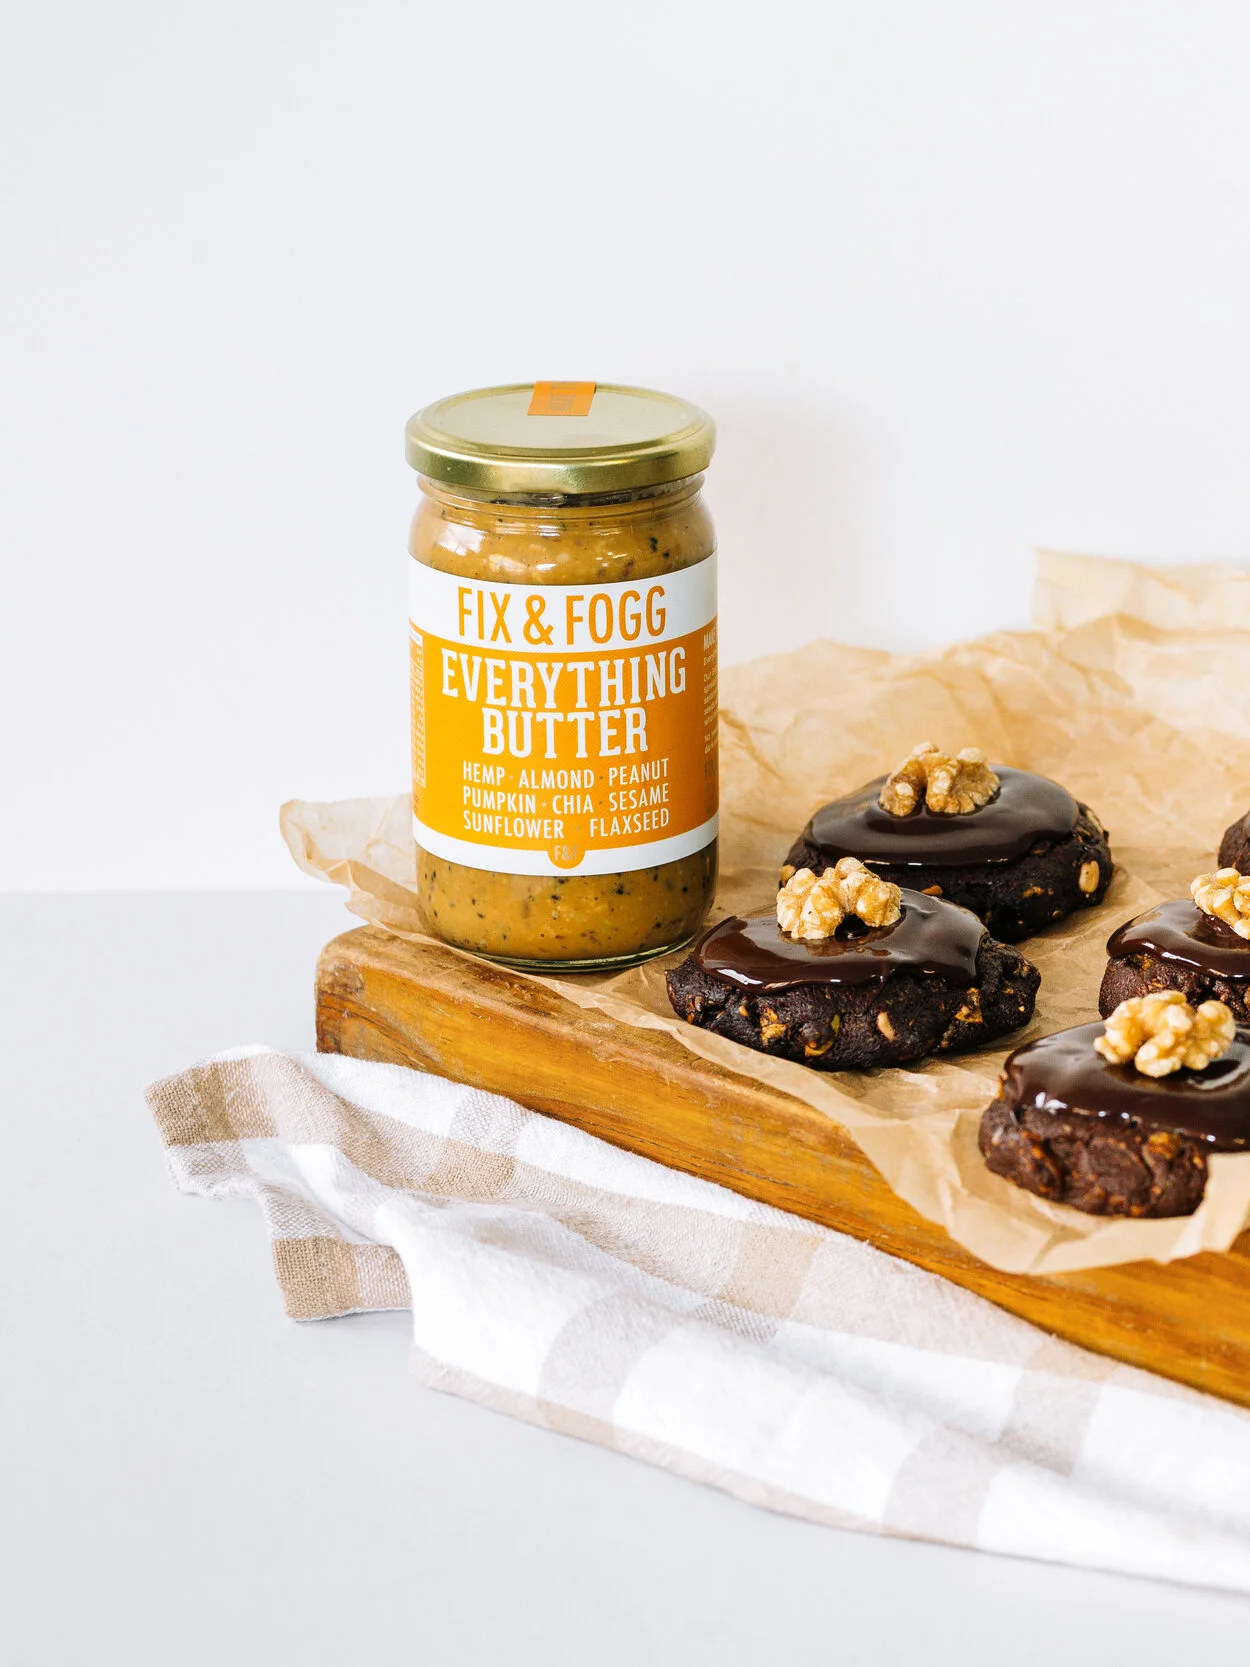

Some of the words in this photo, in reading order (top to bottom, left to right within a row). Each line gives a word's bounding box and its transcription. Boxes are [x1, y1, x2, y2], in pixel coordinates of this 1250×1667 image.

[458, 586, 512, 644] FIX
[523, 594, 554, 646] &
[565, 585, 666, 646] FOGG
[441, 646, 687, 709] EVERYTHING
[482, 706, 649, 759] BUTTER
[463, 760, 506, 786] HEMP
[518, 769, 595, 790] ALMOND
[608, 758, 669, 787] PEANUT
[463, 786, 536, 814] PUMPKIN
[552, 795, 594, 815] CHIA
[608, 782, 669, 812] SESAME
[464, 810, 565, 839] SUNFLOWER
[589, 807, 669, 838] FLAXSEED
